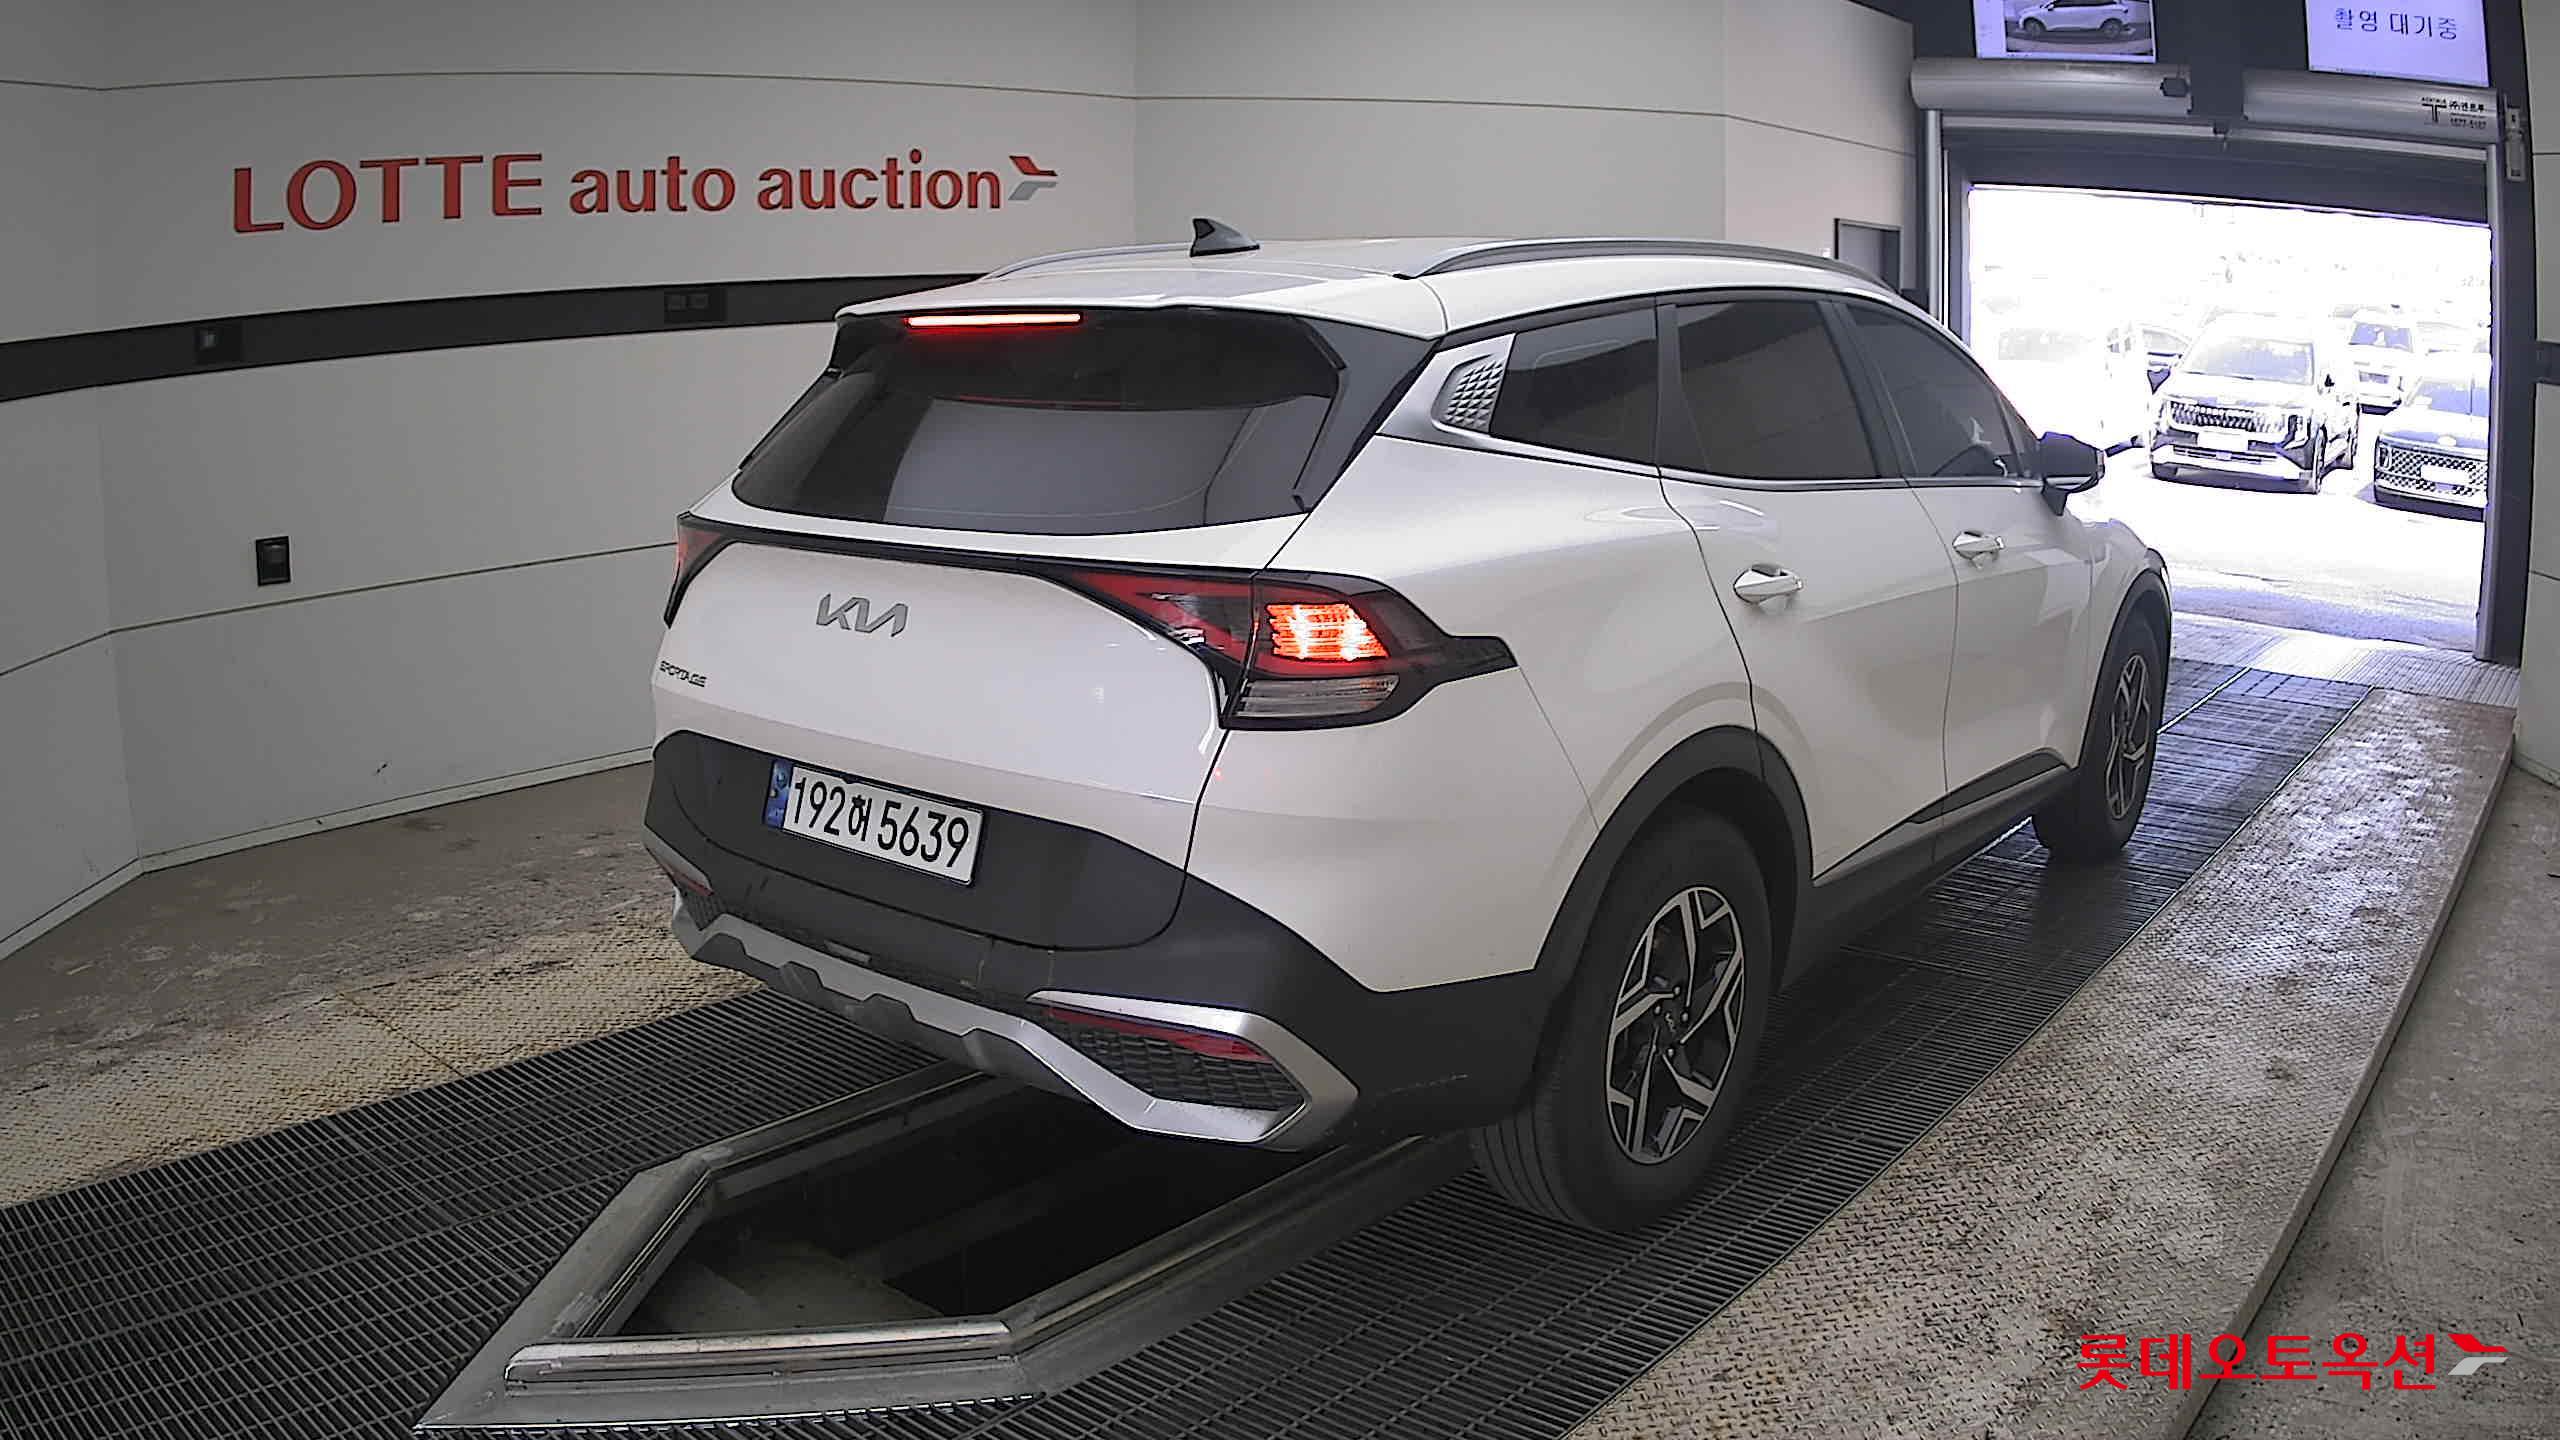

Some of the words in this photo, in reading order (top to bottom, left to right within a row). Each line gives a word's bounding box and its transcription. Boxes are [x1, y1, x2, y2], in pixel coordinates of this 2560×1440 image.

[2336, 8, 2378, 32] 촬영
[233, 152, 543, 234] LOTTE
[569, 156, 736, 214] auto
[756, 149, 1002, 210] auction
[815, 593, 909, 637] KIA
[659, 660, 707, 687] SPORTAGE
